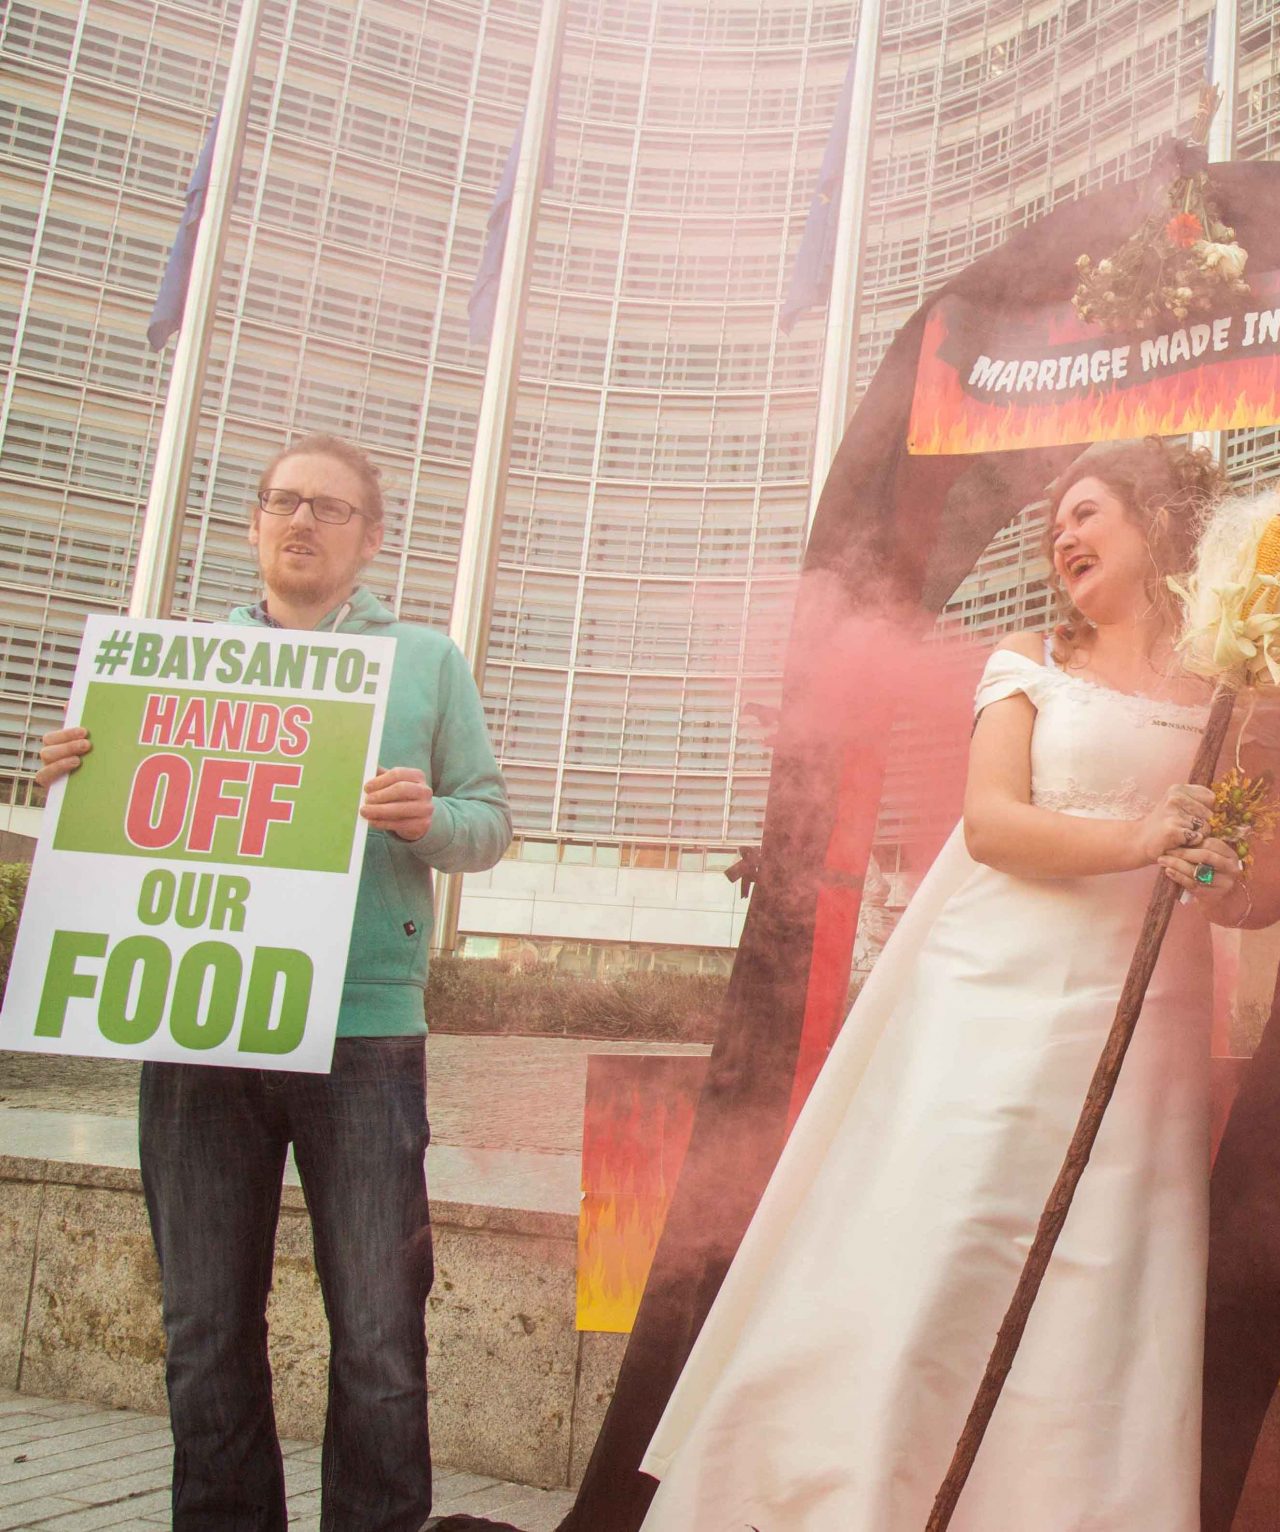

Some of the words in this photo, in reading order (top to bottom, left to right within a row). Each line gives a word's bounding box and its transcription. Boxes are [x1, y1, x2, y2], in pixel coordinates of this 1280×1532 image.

[968, 346, 1130, 394] MARRIAGE
[1140, 317, 1232, 372] MADE
[94, 629, 381, 695] #BAYSANTO:
[139, 695, 313, 757] HANDS
[124, 752, 304, 857] OFF
[137, 868, 251, 932] OUR
[33, 929, 315, 1055] FOOD
